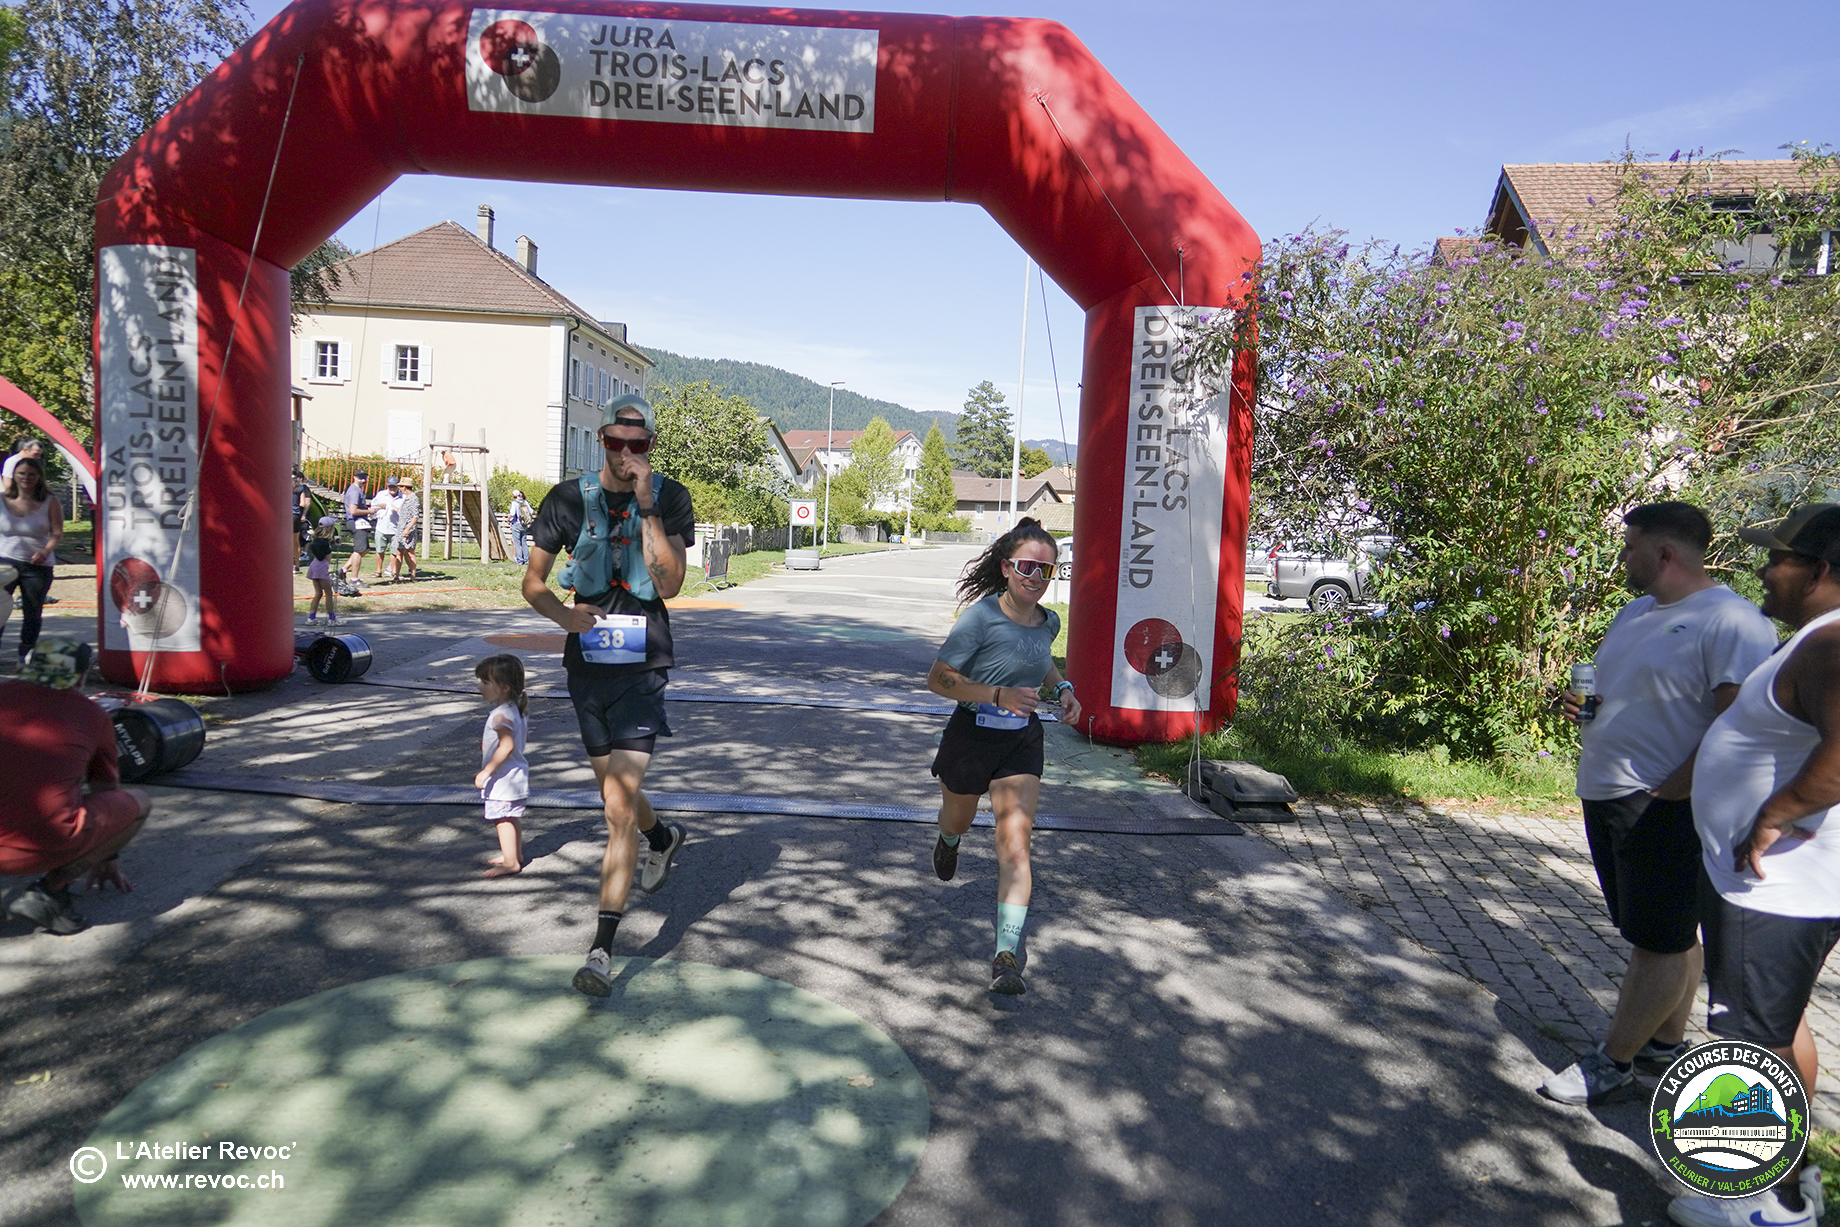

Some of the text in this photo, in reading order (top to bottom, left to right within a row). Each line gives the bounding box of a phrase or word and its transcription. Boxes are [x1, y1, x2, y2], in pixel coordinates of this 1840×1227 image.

[590, 24, 676, 50] JURA
[589, 49, 785, 86] TROIS-LACS
[589, 80, 865, 122] DREI-SEEN-LAND
[157, 256, 187, 529] DREI-SEEN-LAND
[128, 335, 154, 529] TROIS-LACS
[1128, 315, 1169, 589] DREI-SEEN-LAND
[108, 446, 126, 529] JURA
[322, 645, 338, 674] MYLAPS
[598, 629, 625, 648] 38
[114, 723, 146, 766] MYLAPS
